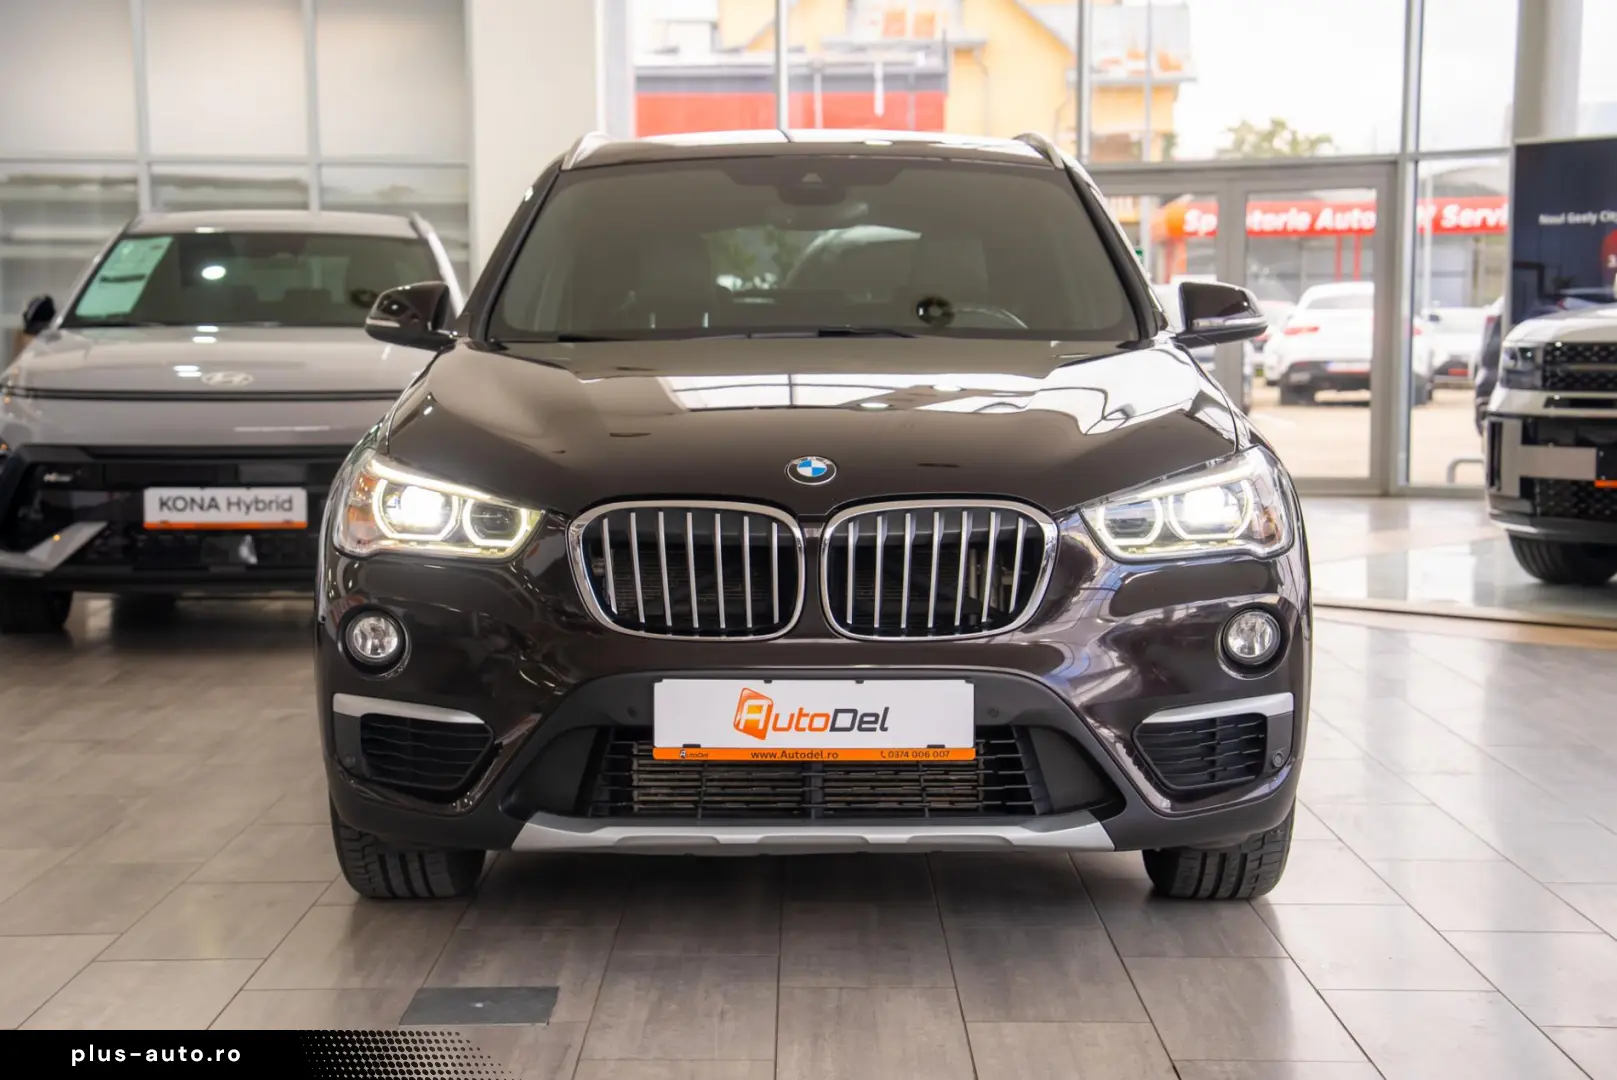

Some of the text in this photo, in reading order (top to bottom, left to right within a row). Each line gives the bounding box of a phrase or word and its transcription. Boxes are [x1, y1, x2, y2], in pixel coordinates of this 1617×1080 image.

[159, 495, 293, 516] KONA Hybrid
[734, 690, 890, 738] AutoDel
[751, 750, 839, 760] www.Autodel.ro
[888, 750, 909, 759] 0374
[932, 750, 949, 759] 007
